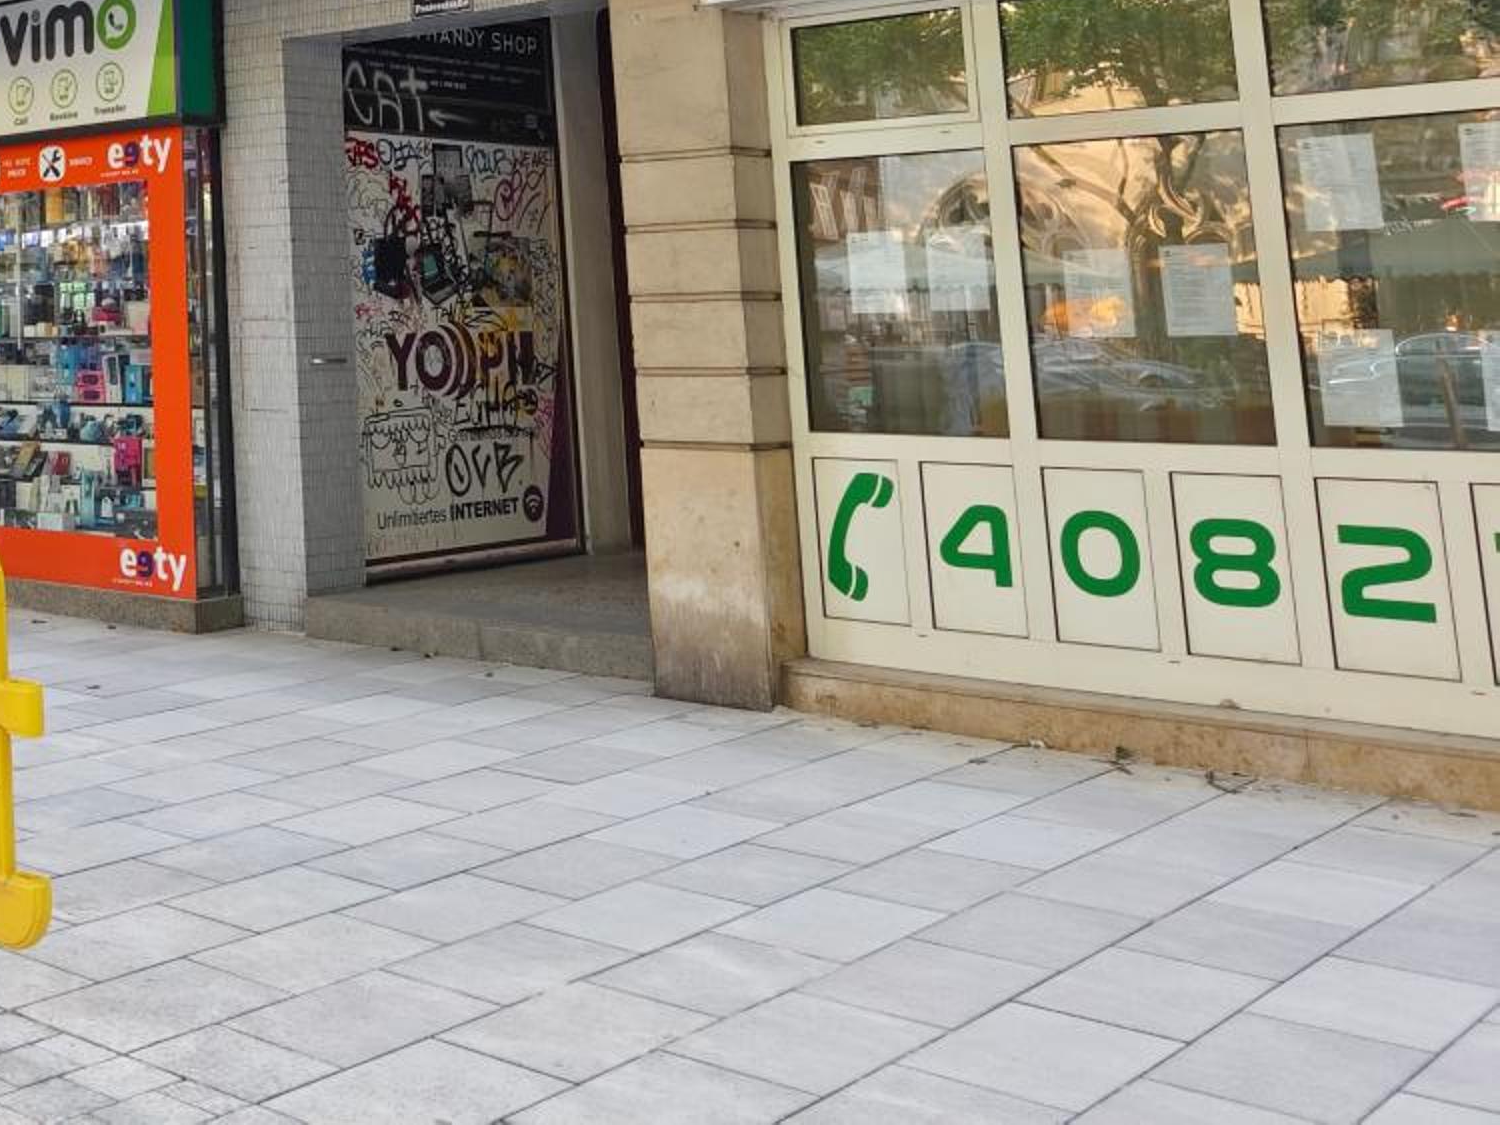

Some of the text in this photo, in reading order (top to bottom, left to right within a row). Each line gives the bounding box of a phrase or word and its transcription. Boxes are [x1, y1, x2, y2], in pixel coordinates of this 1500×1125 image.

[491, 31, 538, 56] SHOP
[450, 496, 519, 522] INTERNET
[939, 503, 1500, 623] 4082
